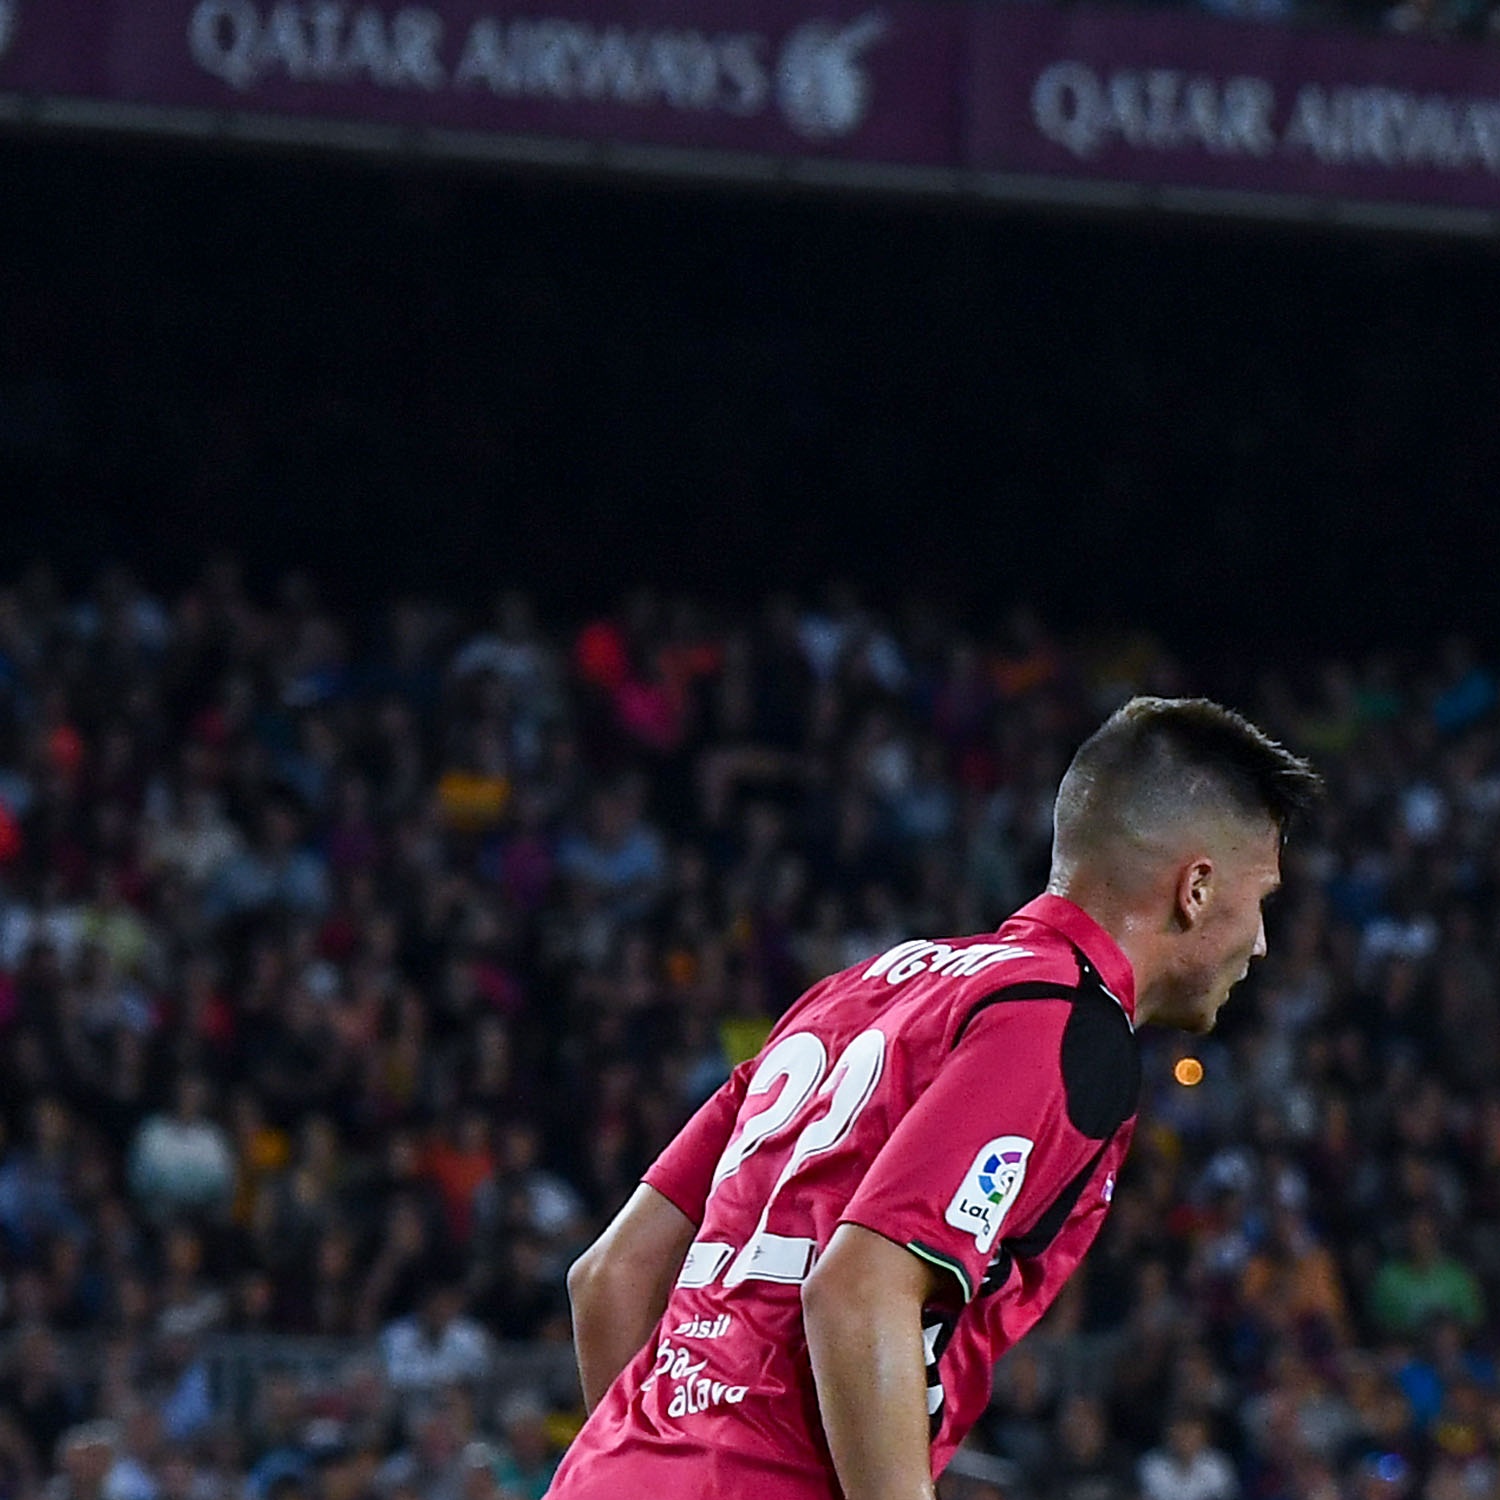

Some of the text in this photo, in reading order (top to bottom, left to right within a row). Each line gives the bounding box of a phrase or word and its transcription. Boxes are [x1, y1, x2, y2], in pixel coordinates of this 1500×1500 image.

[188, 0, 769, 116] QATAR AIRWAYS
[1030, 59, 1278, 160] QATAR
[675, 1028, 886, 1289] 22
